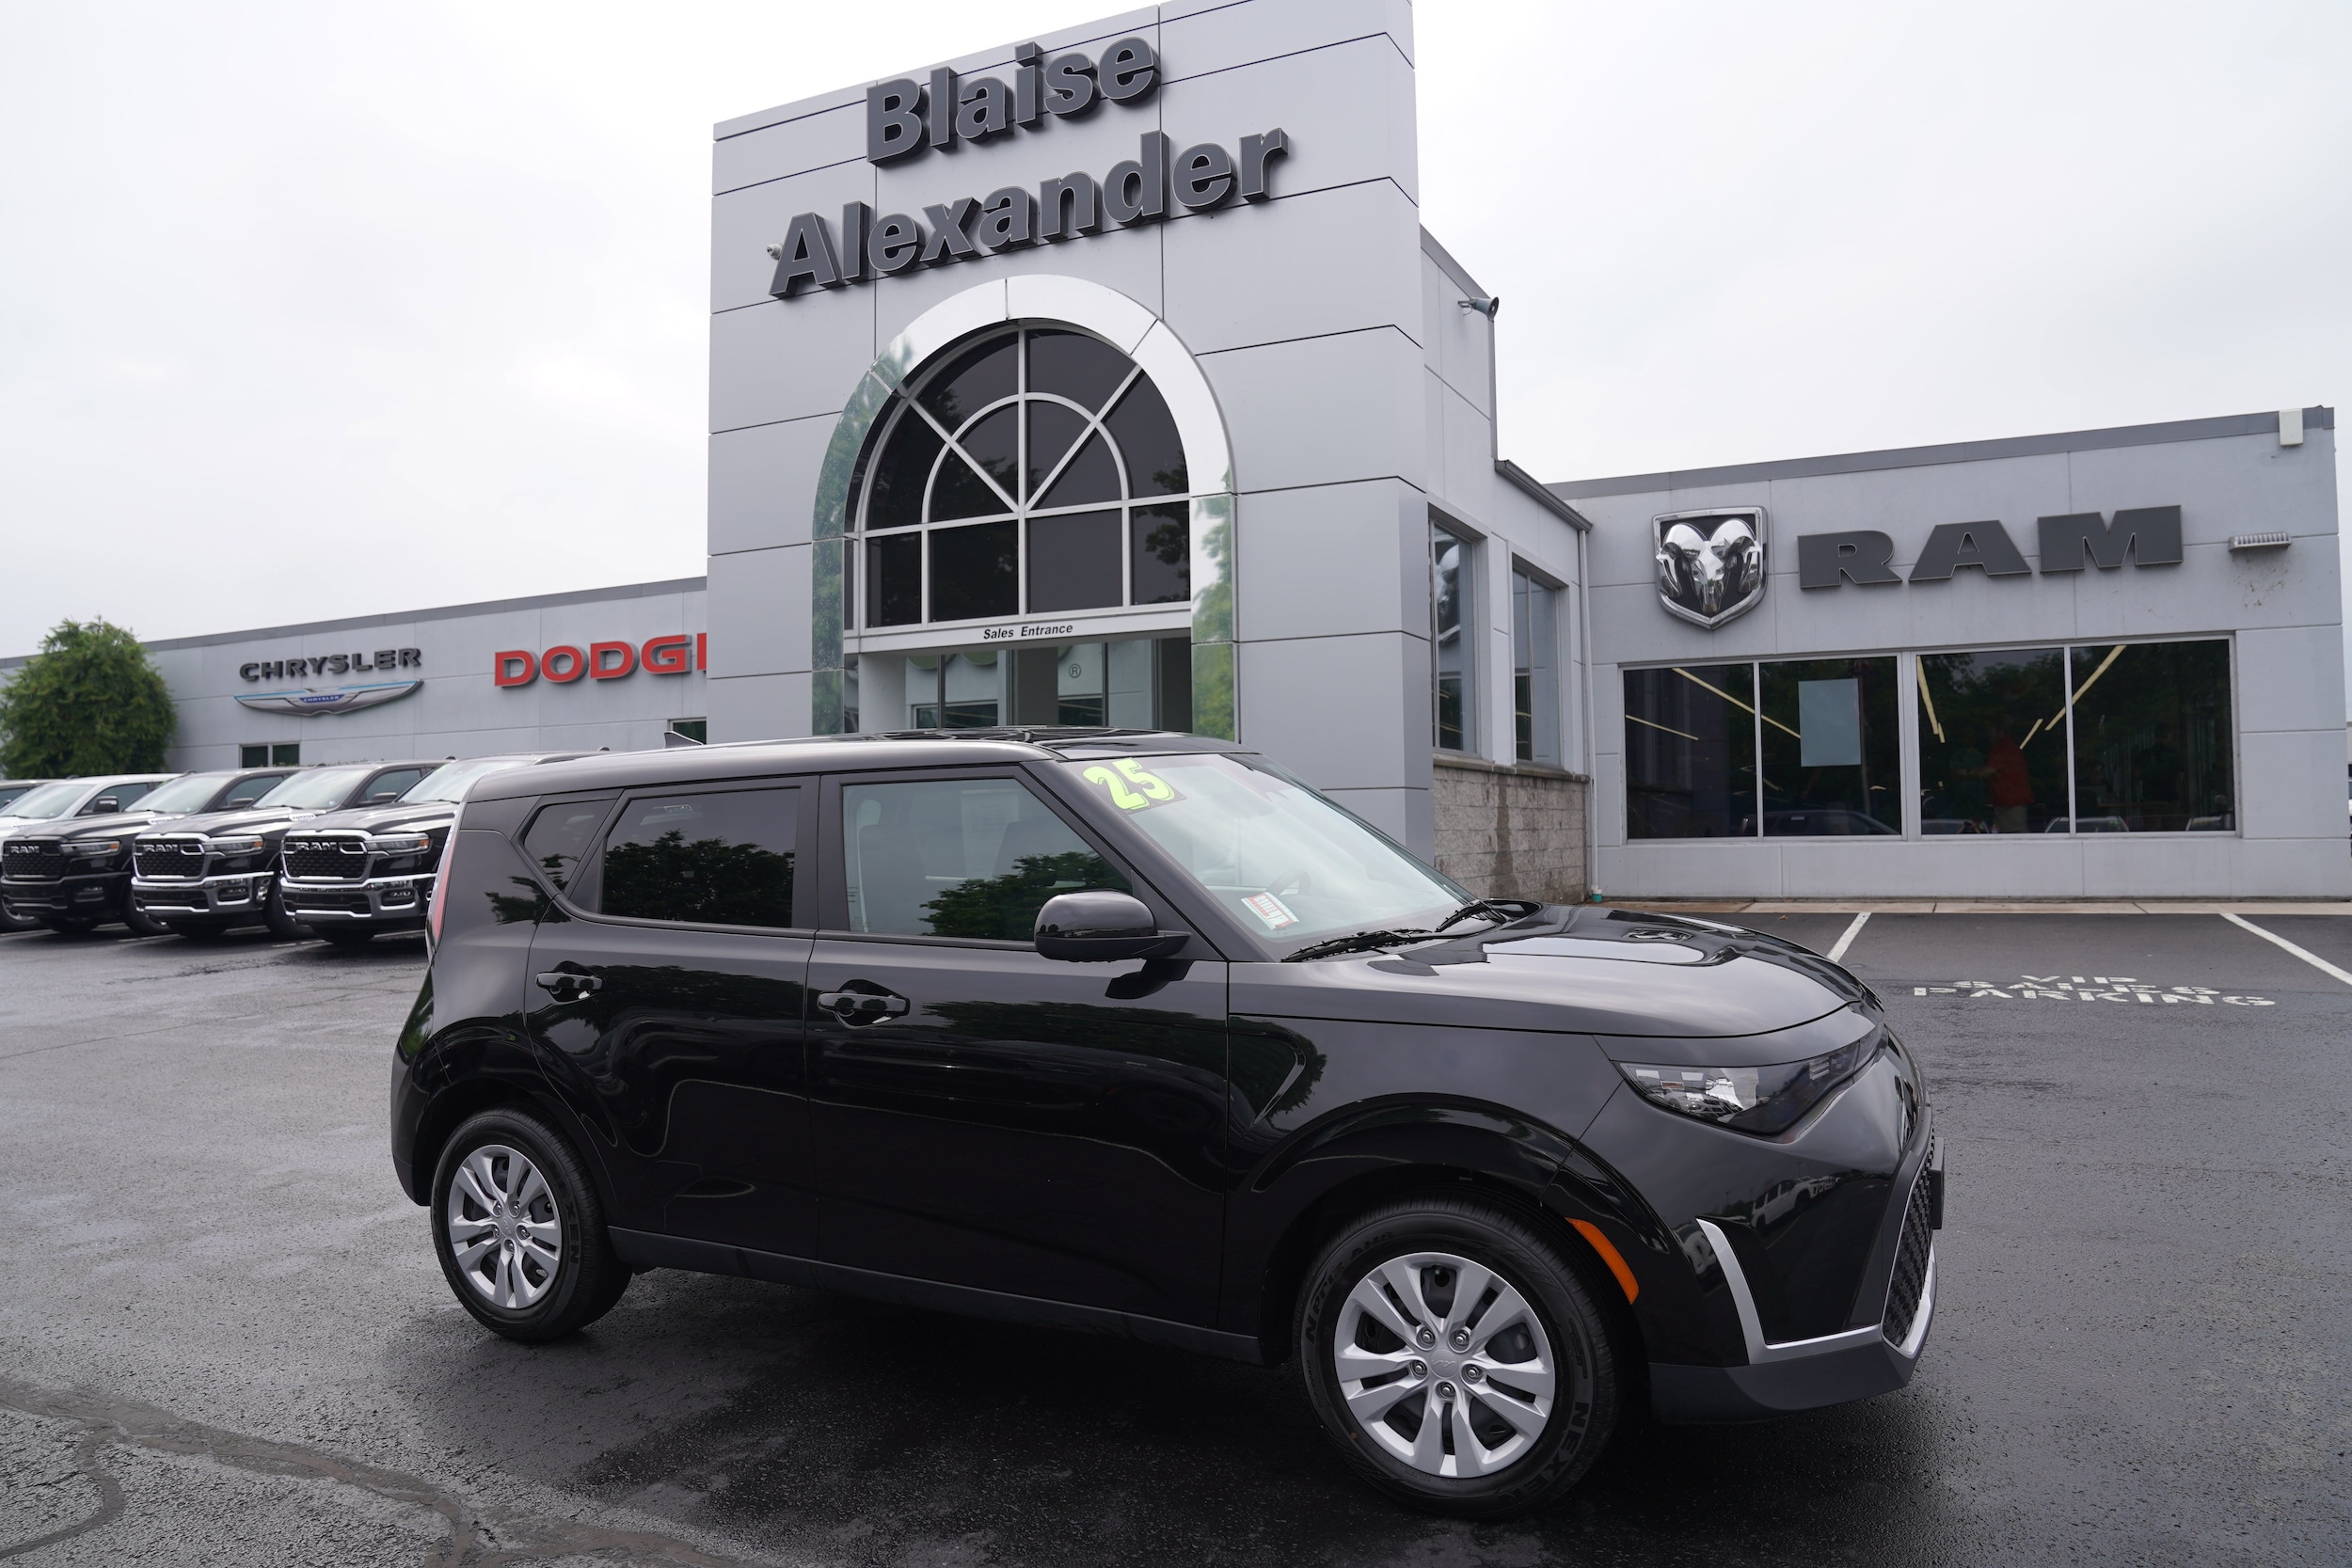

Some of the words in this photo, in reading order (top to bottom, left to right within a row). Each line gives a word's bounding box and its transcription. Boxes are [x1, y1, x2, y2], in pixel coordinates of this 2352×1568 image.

[866, 37, 1160, 166] Blaise
[769, 127, 1288, 299] Alexander
[1797, 504, 2184, 590] RAM
[983, 627, 1014, 640] Sales
[1021, 625, 1073, 637] Entrance
[239, 647, 422, 682] CHRYSLER
[1083, 757, 1176, 810] 25
[10, 845, 40, 854] RAM
[143, 844, 178, 853] RAM
[295, 841, 338, 850] RAM
[1914, 987, 2276, 1006] PARKING
